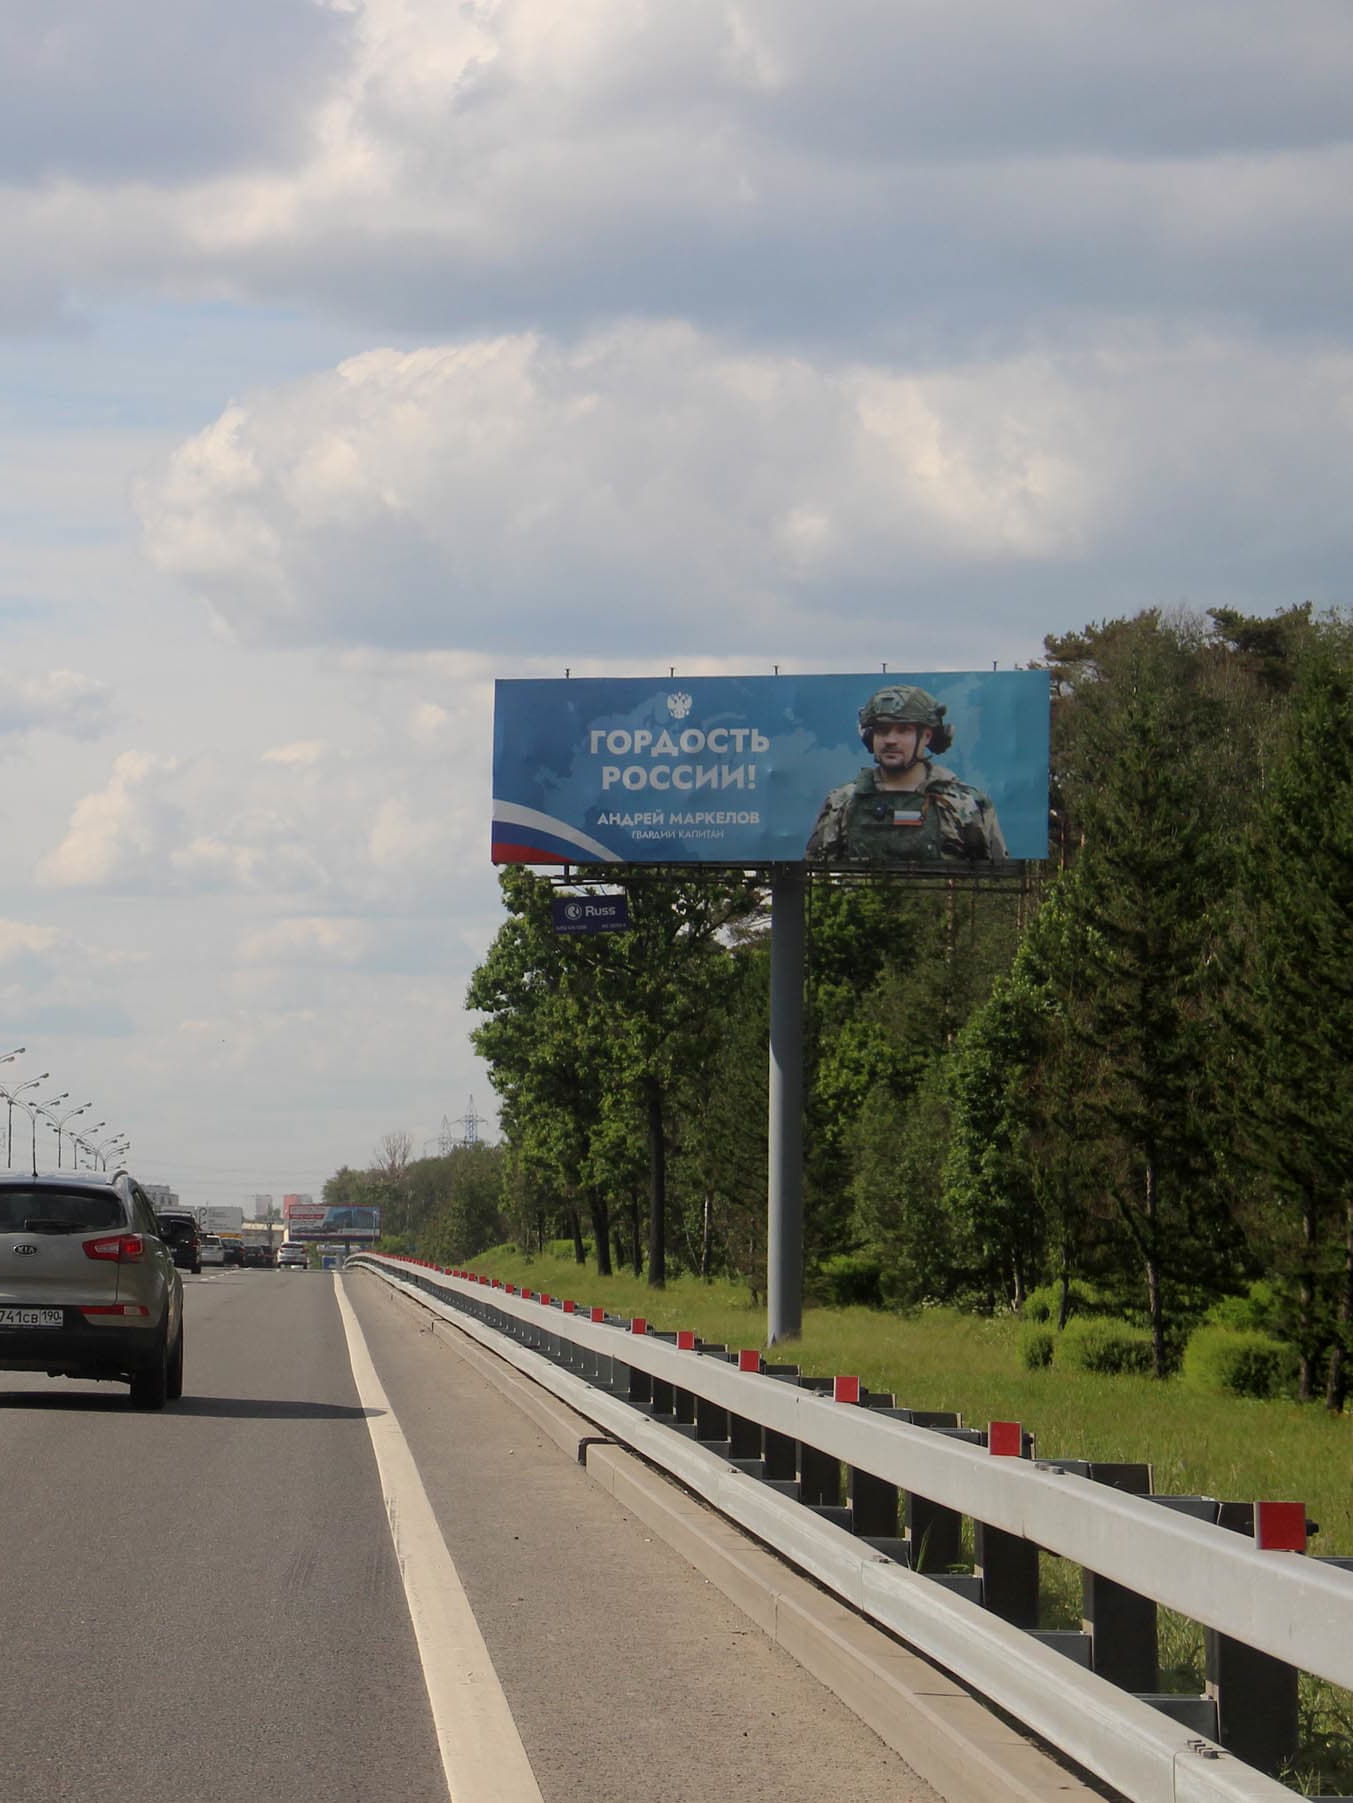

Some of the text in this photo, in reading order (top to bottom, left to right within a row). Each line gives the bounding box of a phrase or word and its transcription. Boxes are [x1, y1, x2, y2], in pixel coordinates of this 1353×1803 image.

[589, 728, 770, 757] ГОРДОСТЬ
[601, 764, 757, 790] РОССИИ!
[597, 809, 761, 826] АНДРЕЙ МАРКЕЛОВ
[631, 829, 725, 840] ГВАРДИИ КАПИТАН
[585, 905, 616, 917] Russ
[16, 1244, 37, 1255] KIA
[42, 1311, 60, 1321] 190
